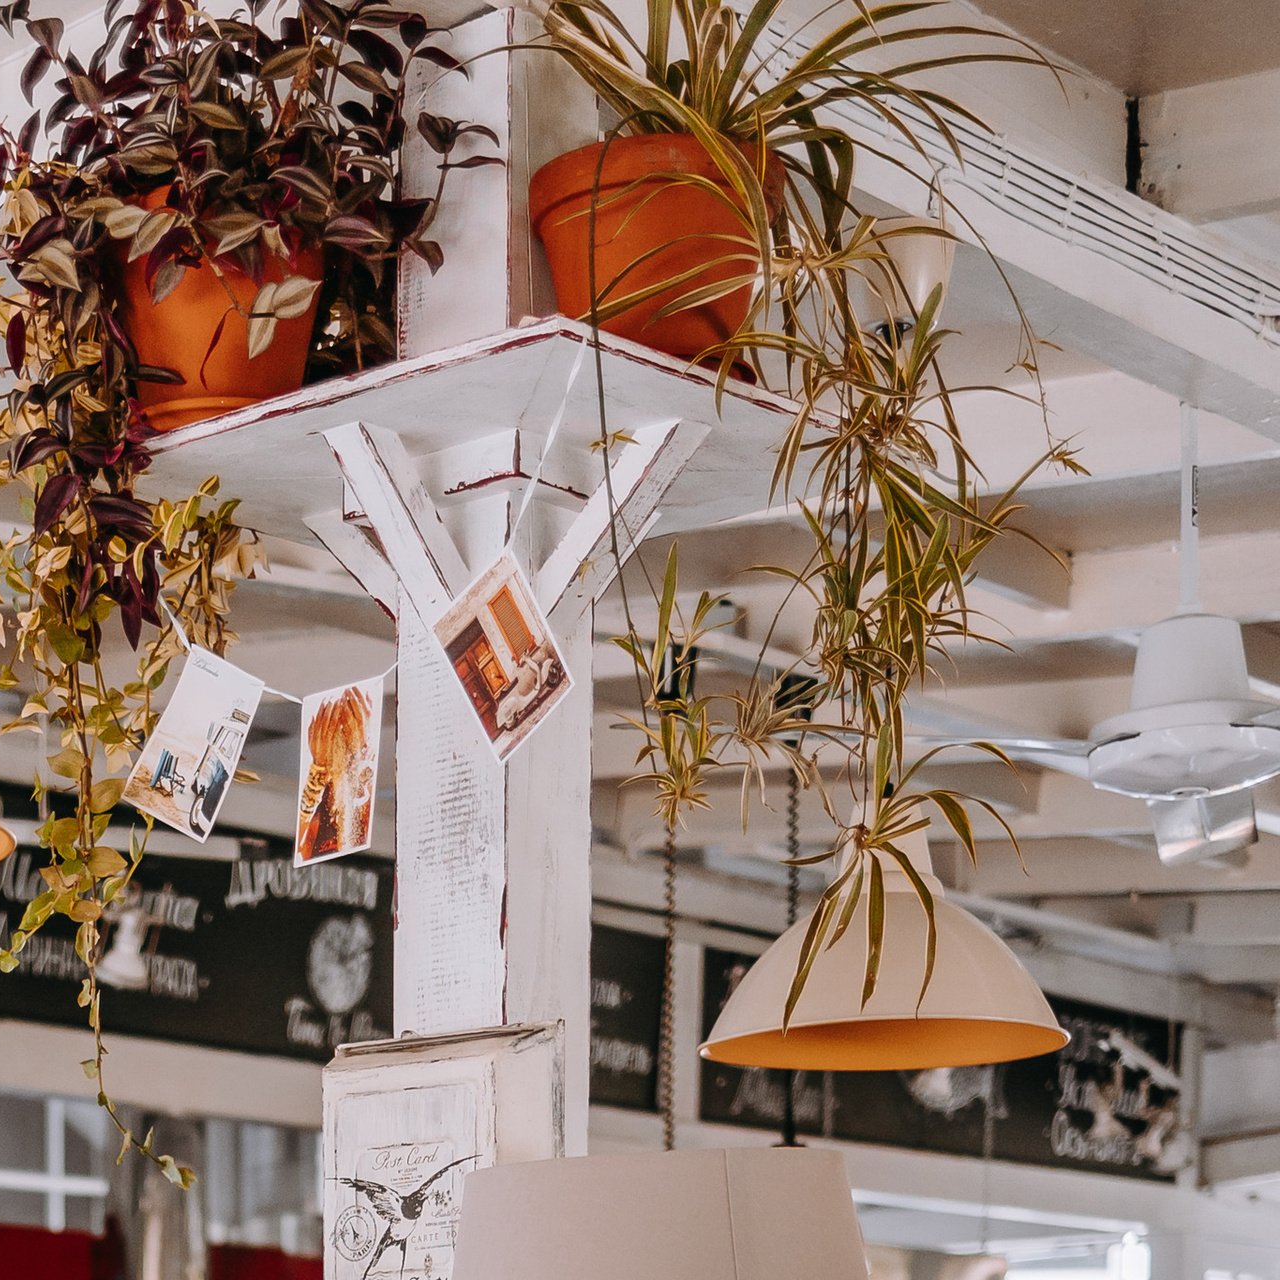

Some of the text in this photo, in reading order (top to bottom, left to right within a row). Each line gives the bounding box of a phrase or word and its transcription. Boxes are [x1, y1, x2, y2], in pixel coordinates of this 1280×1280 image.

[372, 1146, 440, 1170] Post Card
[410, 1232, 438, 1244] CARTE
